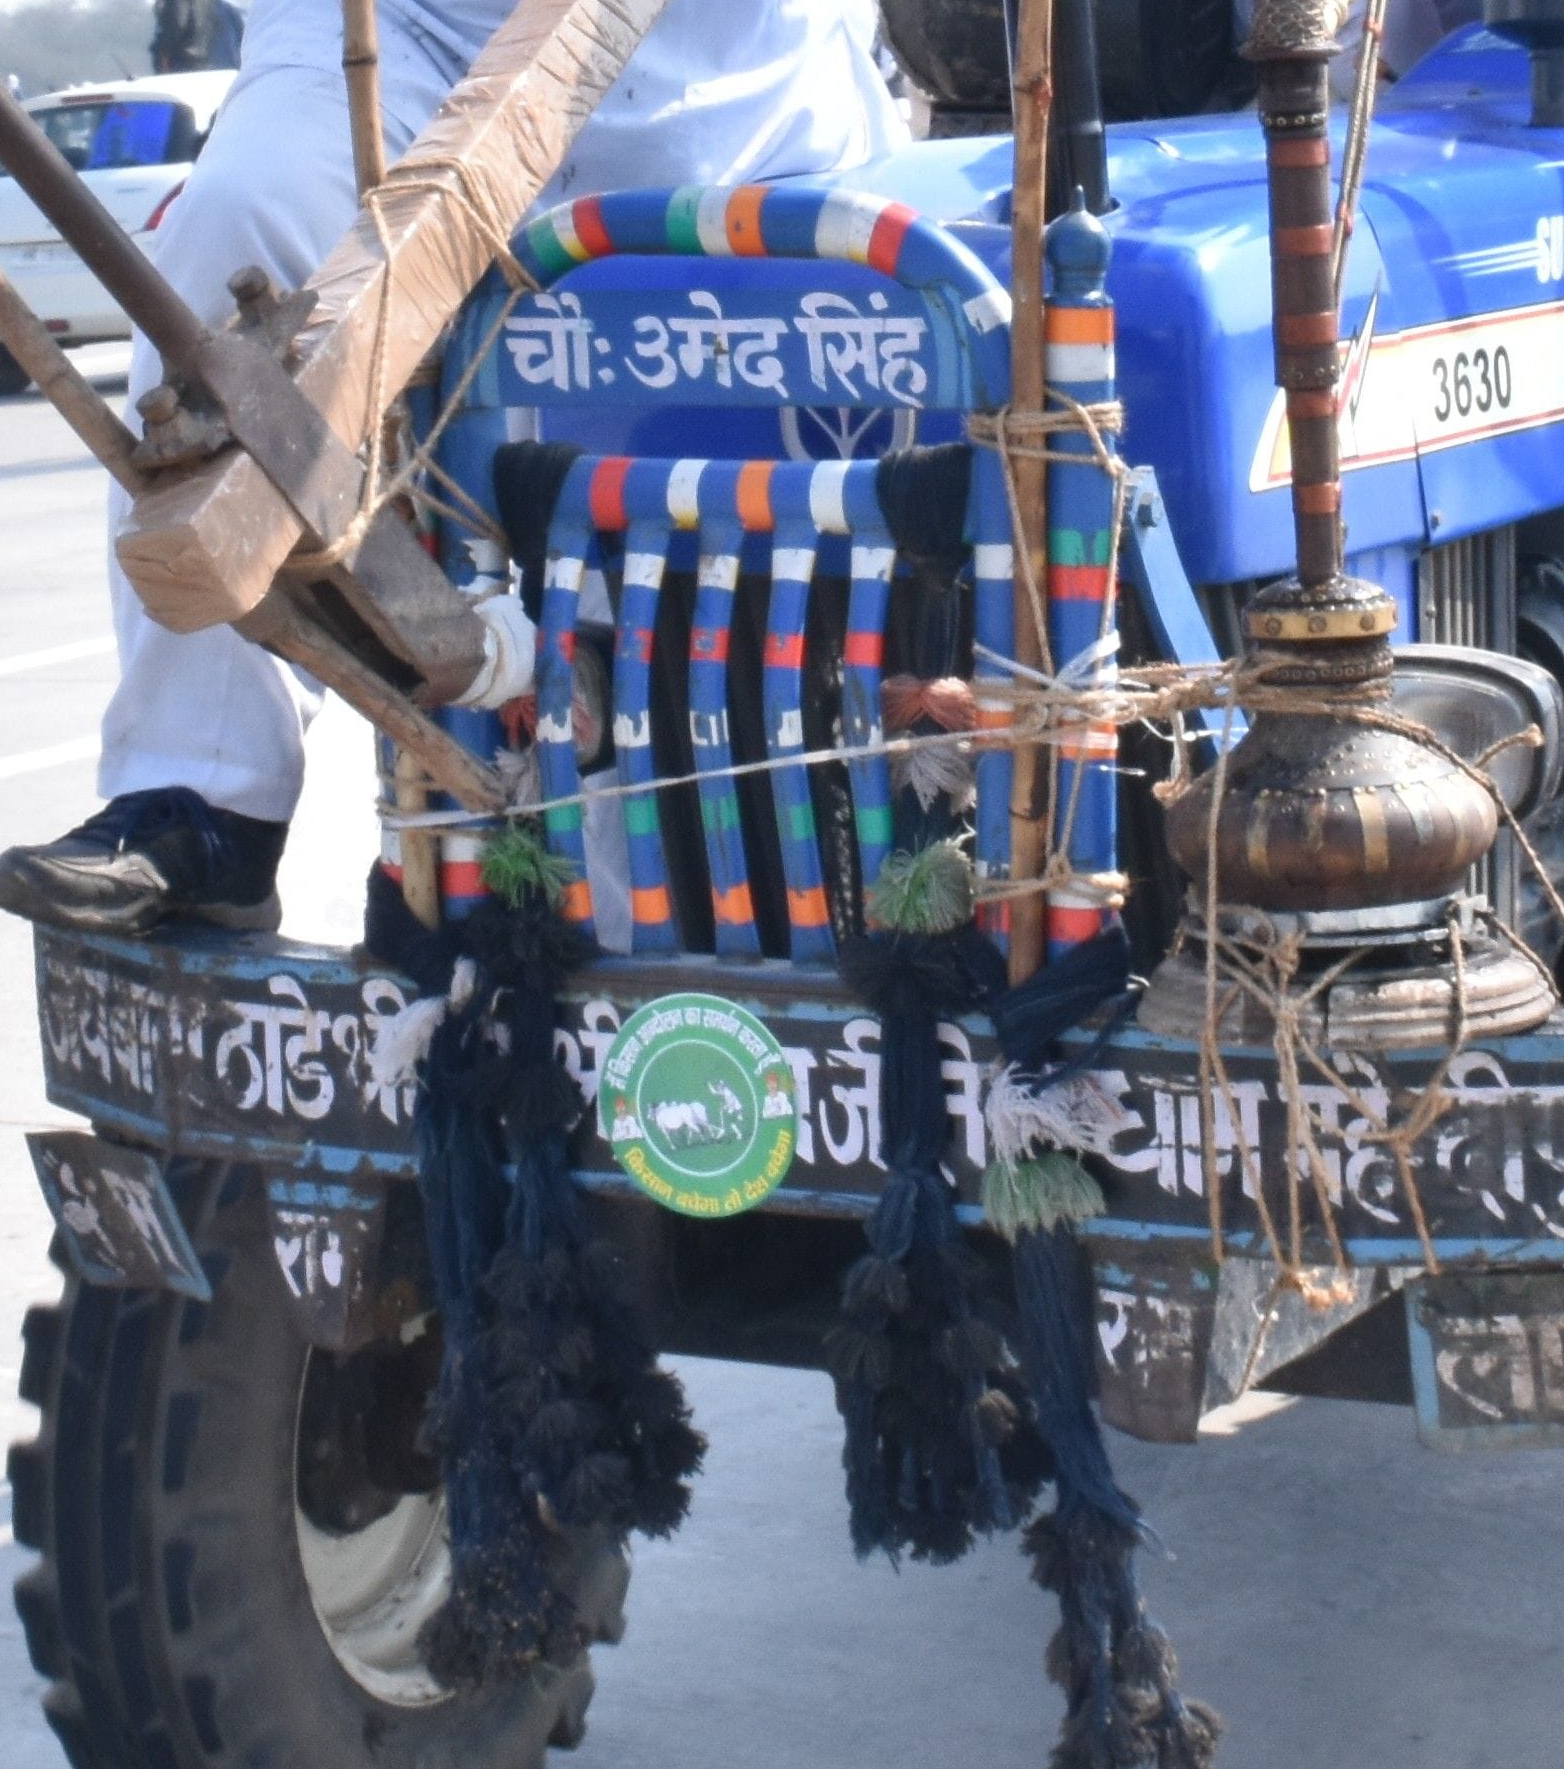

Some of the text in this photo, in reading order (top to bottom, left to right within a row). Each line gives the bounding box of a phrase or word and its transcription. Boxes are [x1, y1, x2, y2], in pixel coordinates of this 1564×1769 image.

[624, 289, 790, 399] उमेद
[794, 290, 928, 409] सिंह
[1431, 344, 1514, 424] 3630
[724, 1188, 744, 1212] तो
